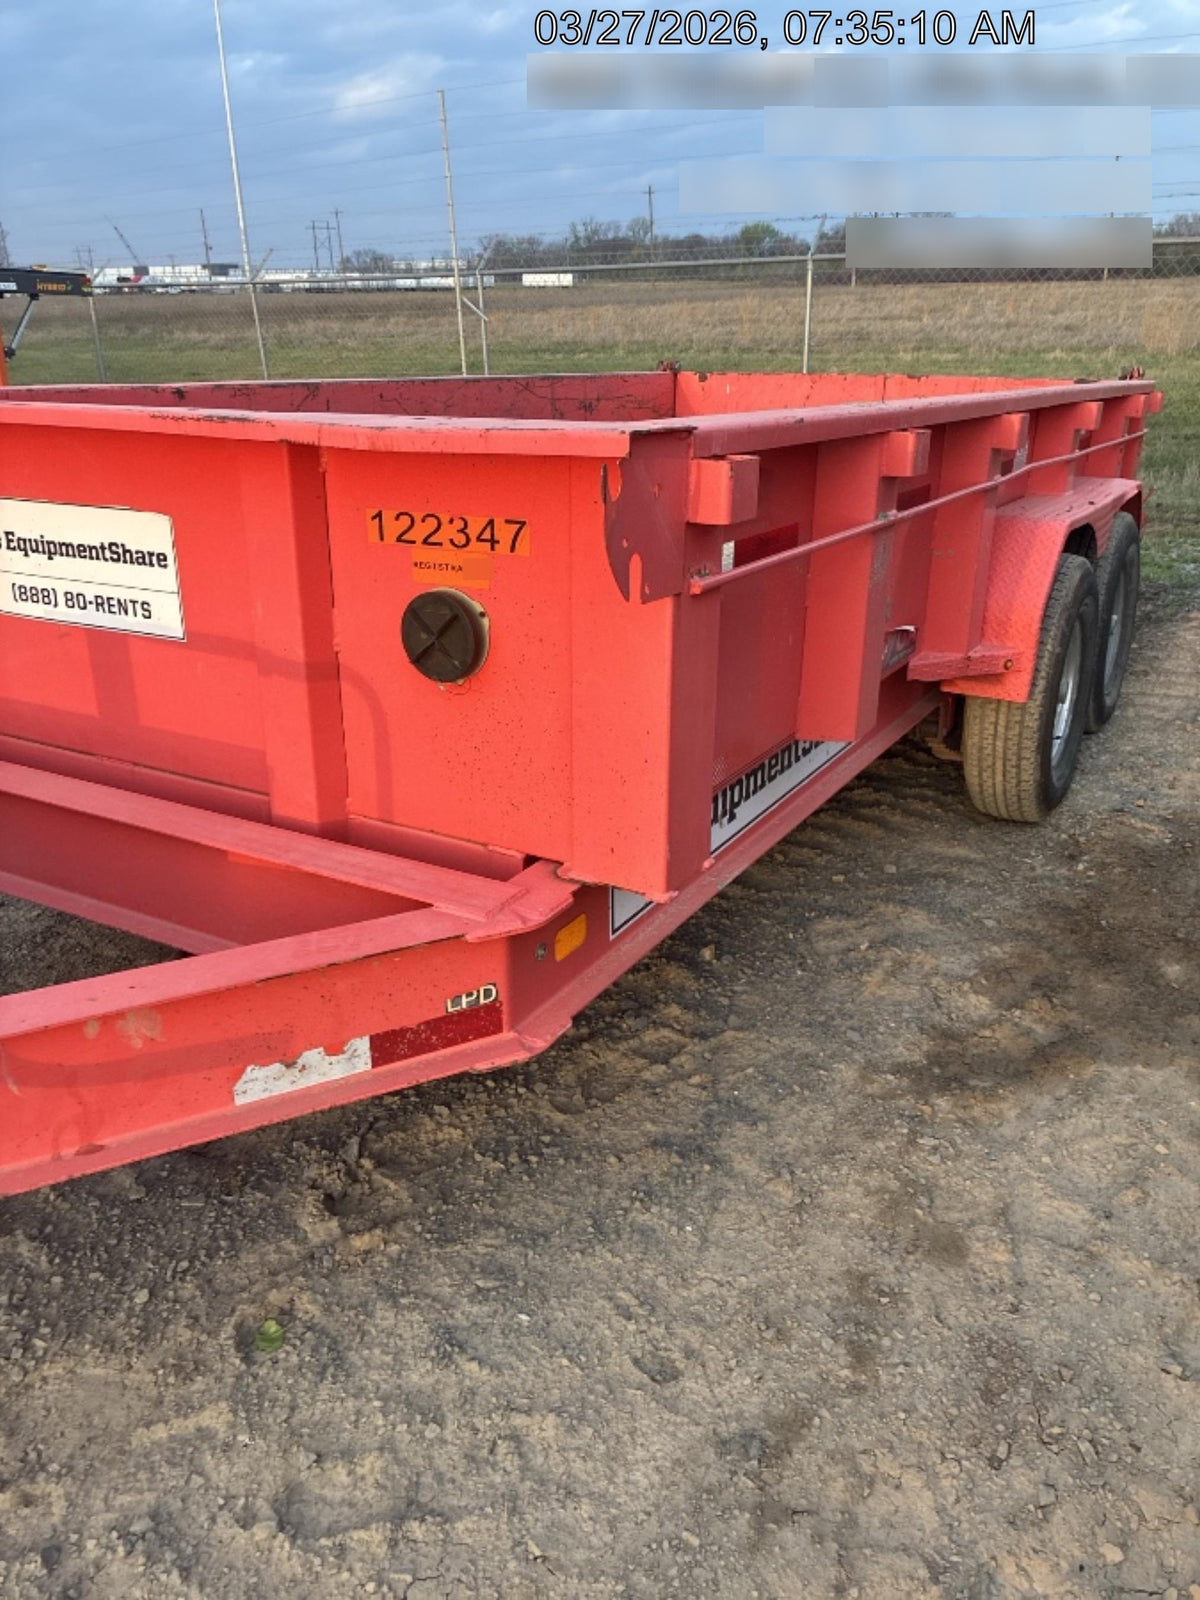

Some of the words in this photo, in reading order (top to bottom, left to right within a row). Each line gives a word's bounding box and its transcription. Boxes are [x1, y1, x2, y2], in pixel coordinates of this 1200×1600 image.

[4, 531, 168, 568] EquipmentShare
[371, 510, 527, 553] 122347
[12, 583, 58, 608] (888)
[64, 591, 152, 619] 80-RENTS
[447, 985, 496, 1012] LPD
